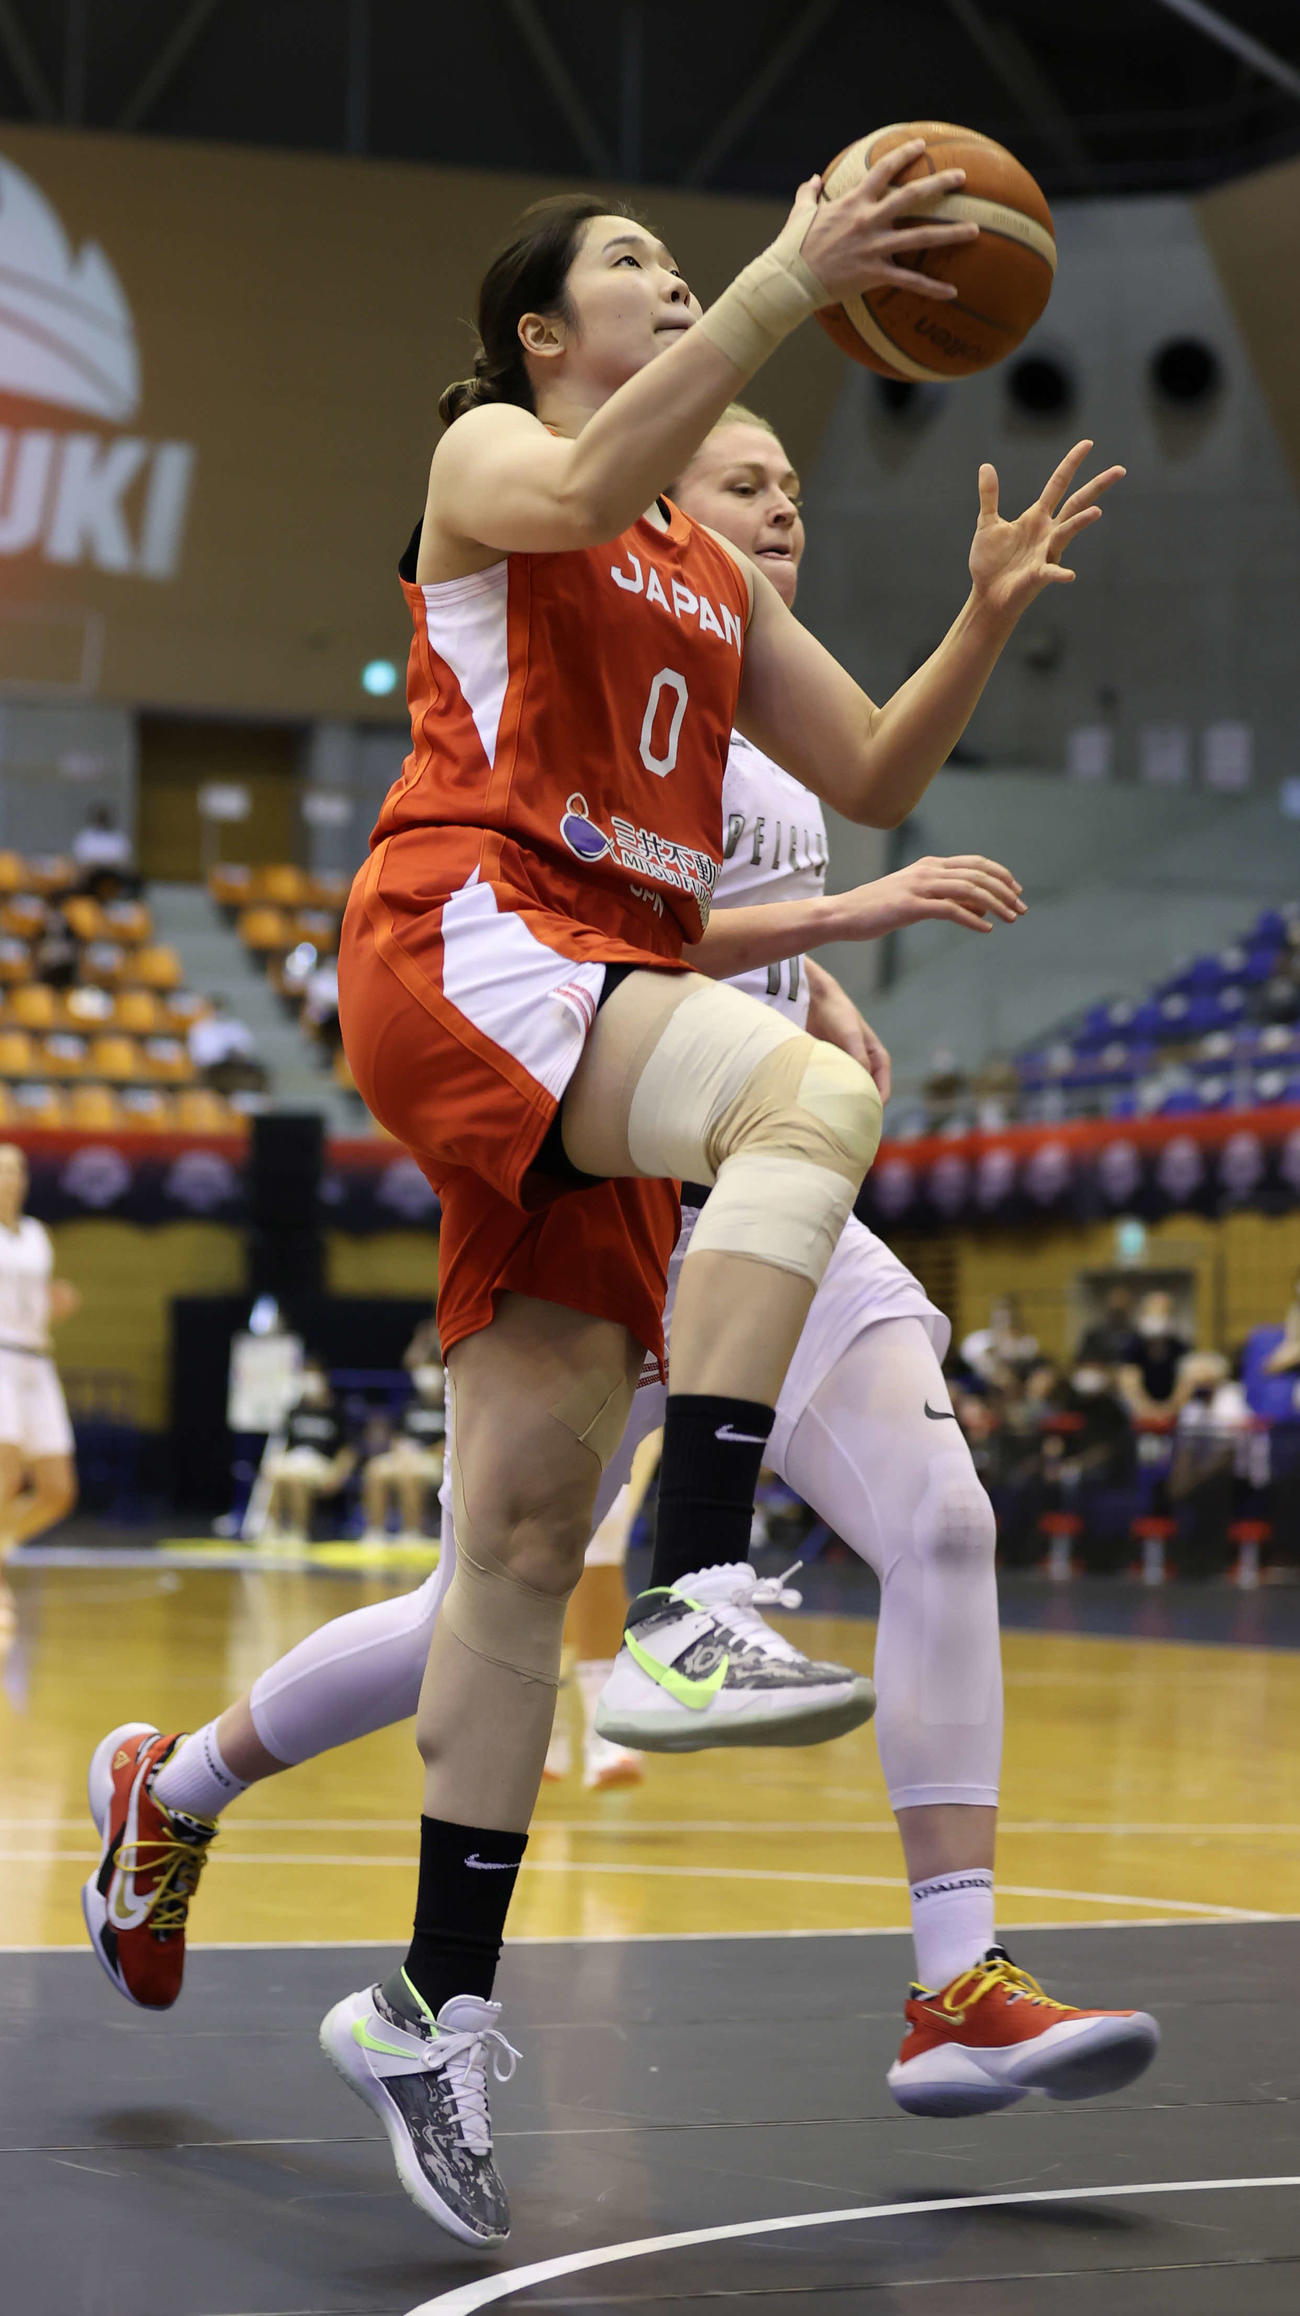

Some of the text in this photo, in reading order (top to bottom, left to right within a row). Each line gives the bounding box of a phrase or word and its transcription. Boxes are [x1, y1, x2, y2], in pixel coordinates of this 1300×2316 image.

[610, 551, 742, 657] JAPAN
[639, 667, 689, 778] 0
[611, 816, 722, 890] 三井不動
[621, 850, 682, 888] MITSUI
